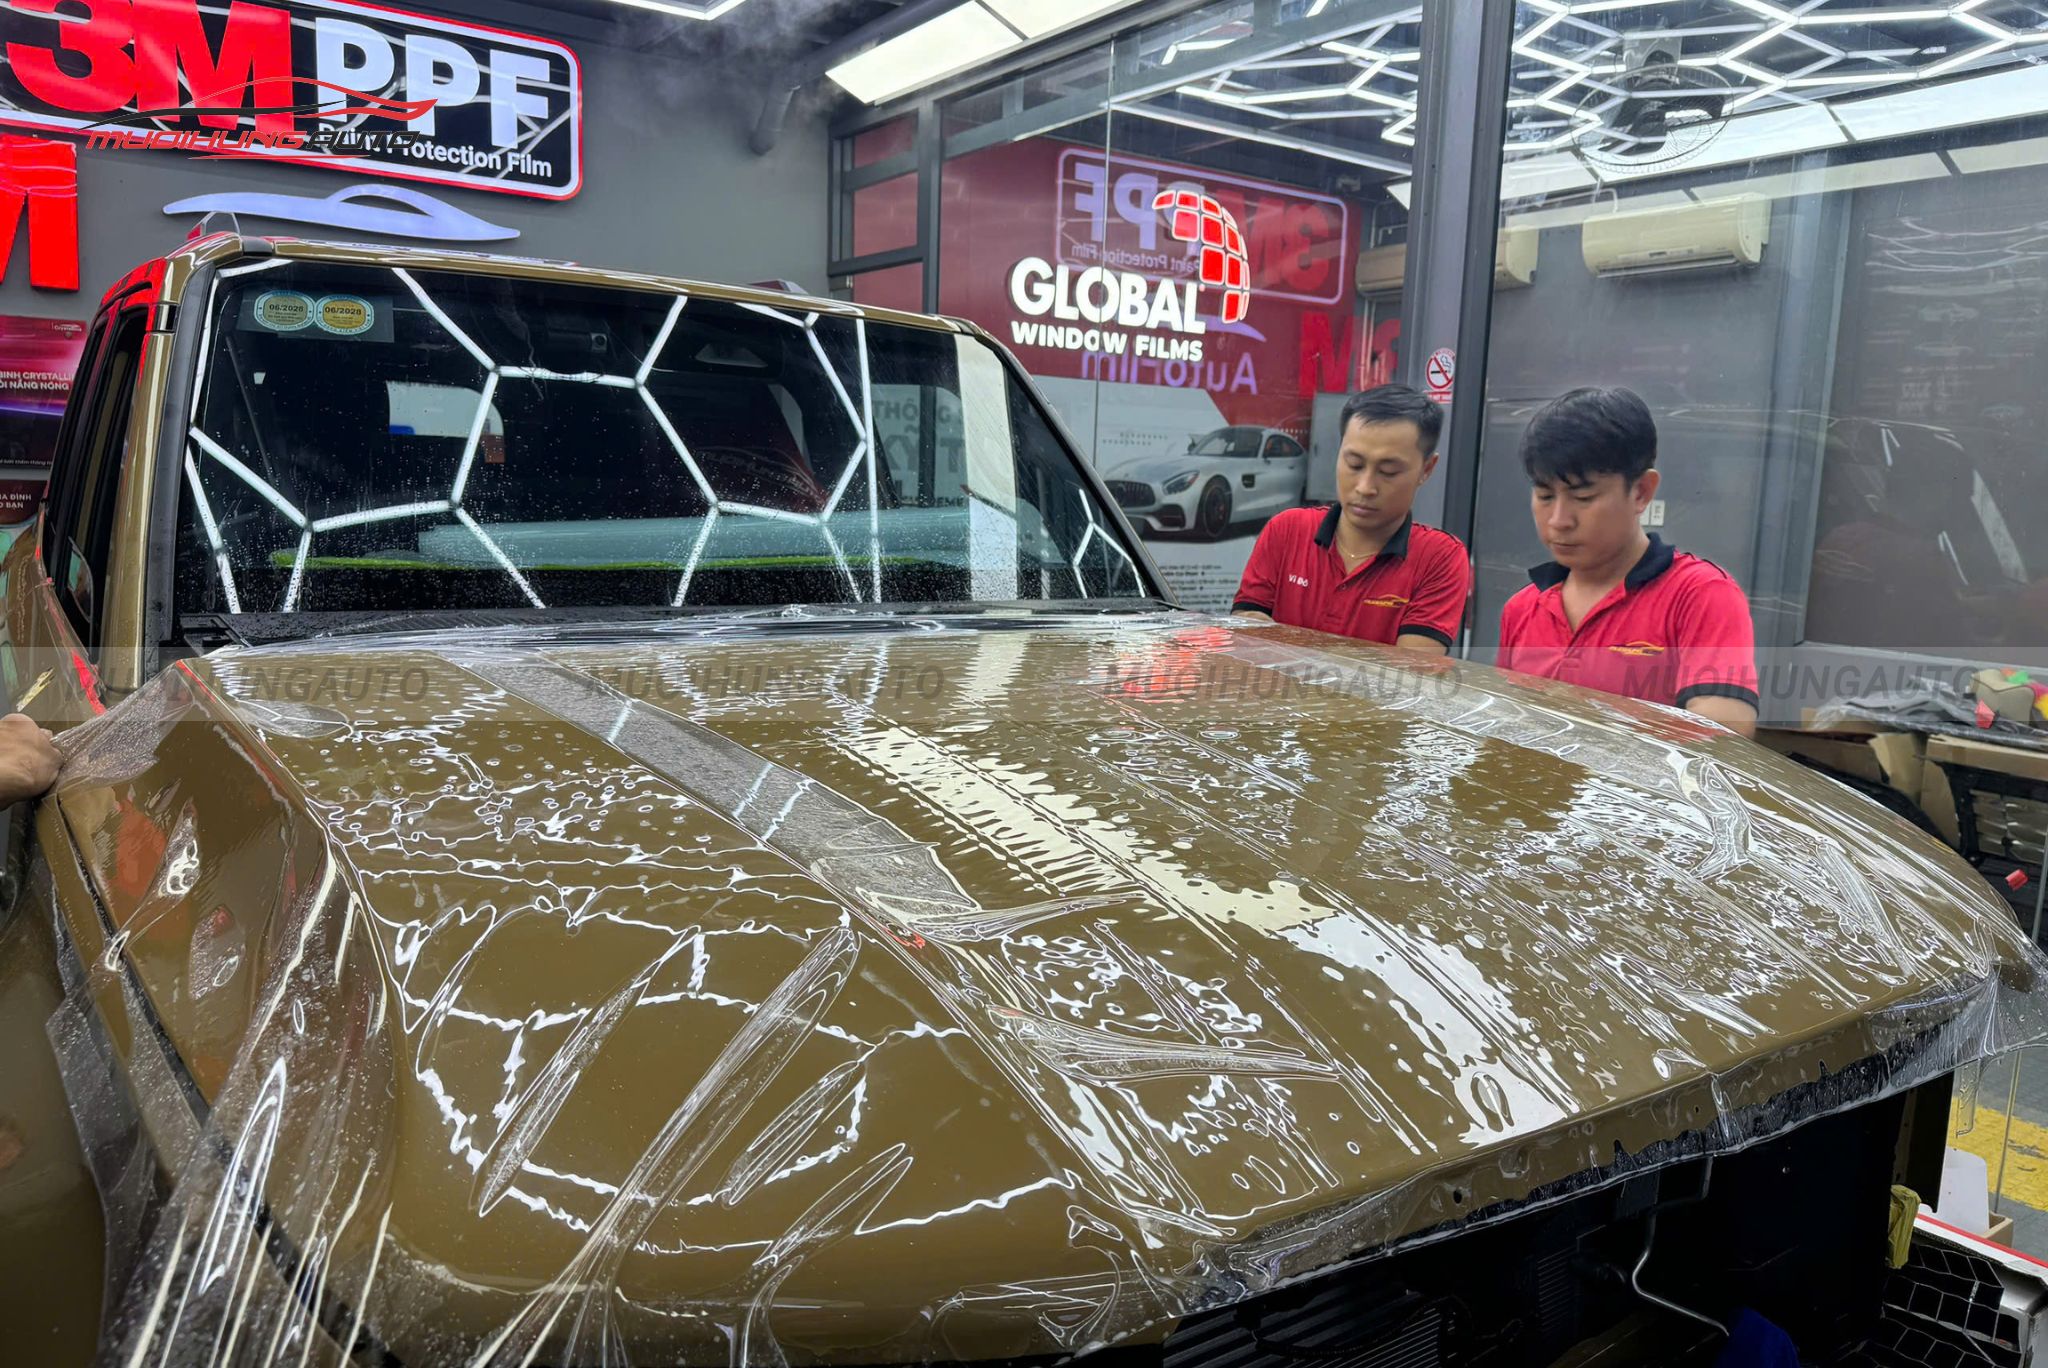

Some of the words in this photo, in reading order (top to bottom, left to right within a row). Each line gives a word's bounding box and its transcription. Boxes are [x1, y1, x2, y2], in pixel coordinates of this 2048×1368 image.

[7, 0, 295, 133] 3M
[316, 17, 550, 149] PPF
[386, 135, 501, 170] Protection
[507, 152, 552, 177] Film
[1010, 257, 1205, 334] GLOBAL
[1011, 320, 1127, 354] WINDOW
[1135, 335, 1203, 363] FILMS
[873, 397, 951, 424] THÔG
